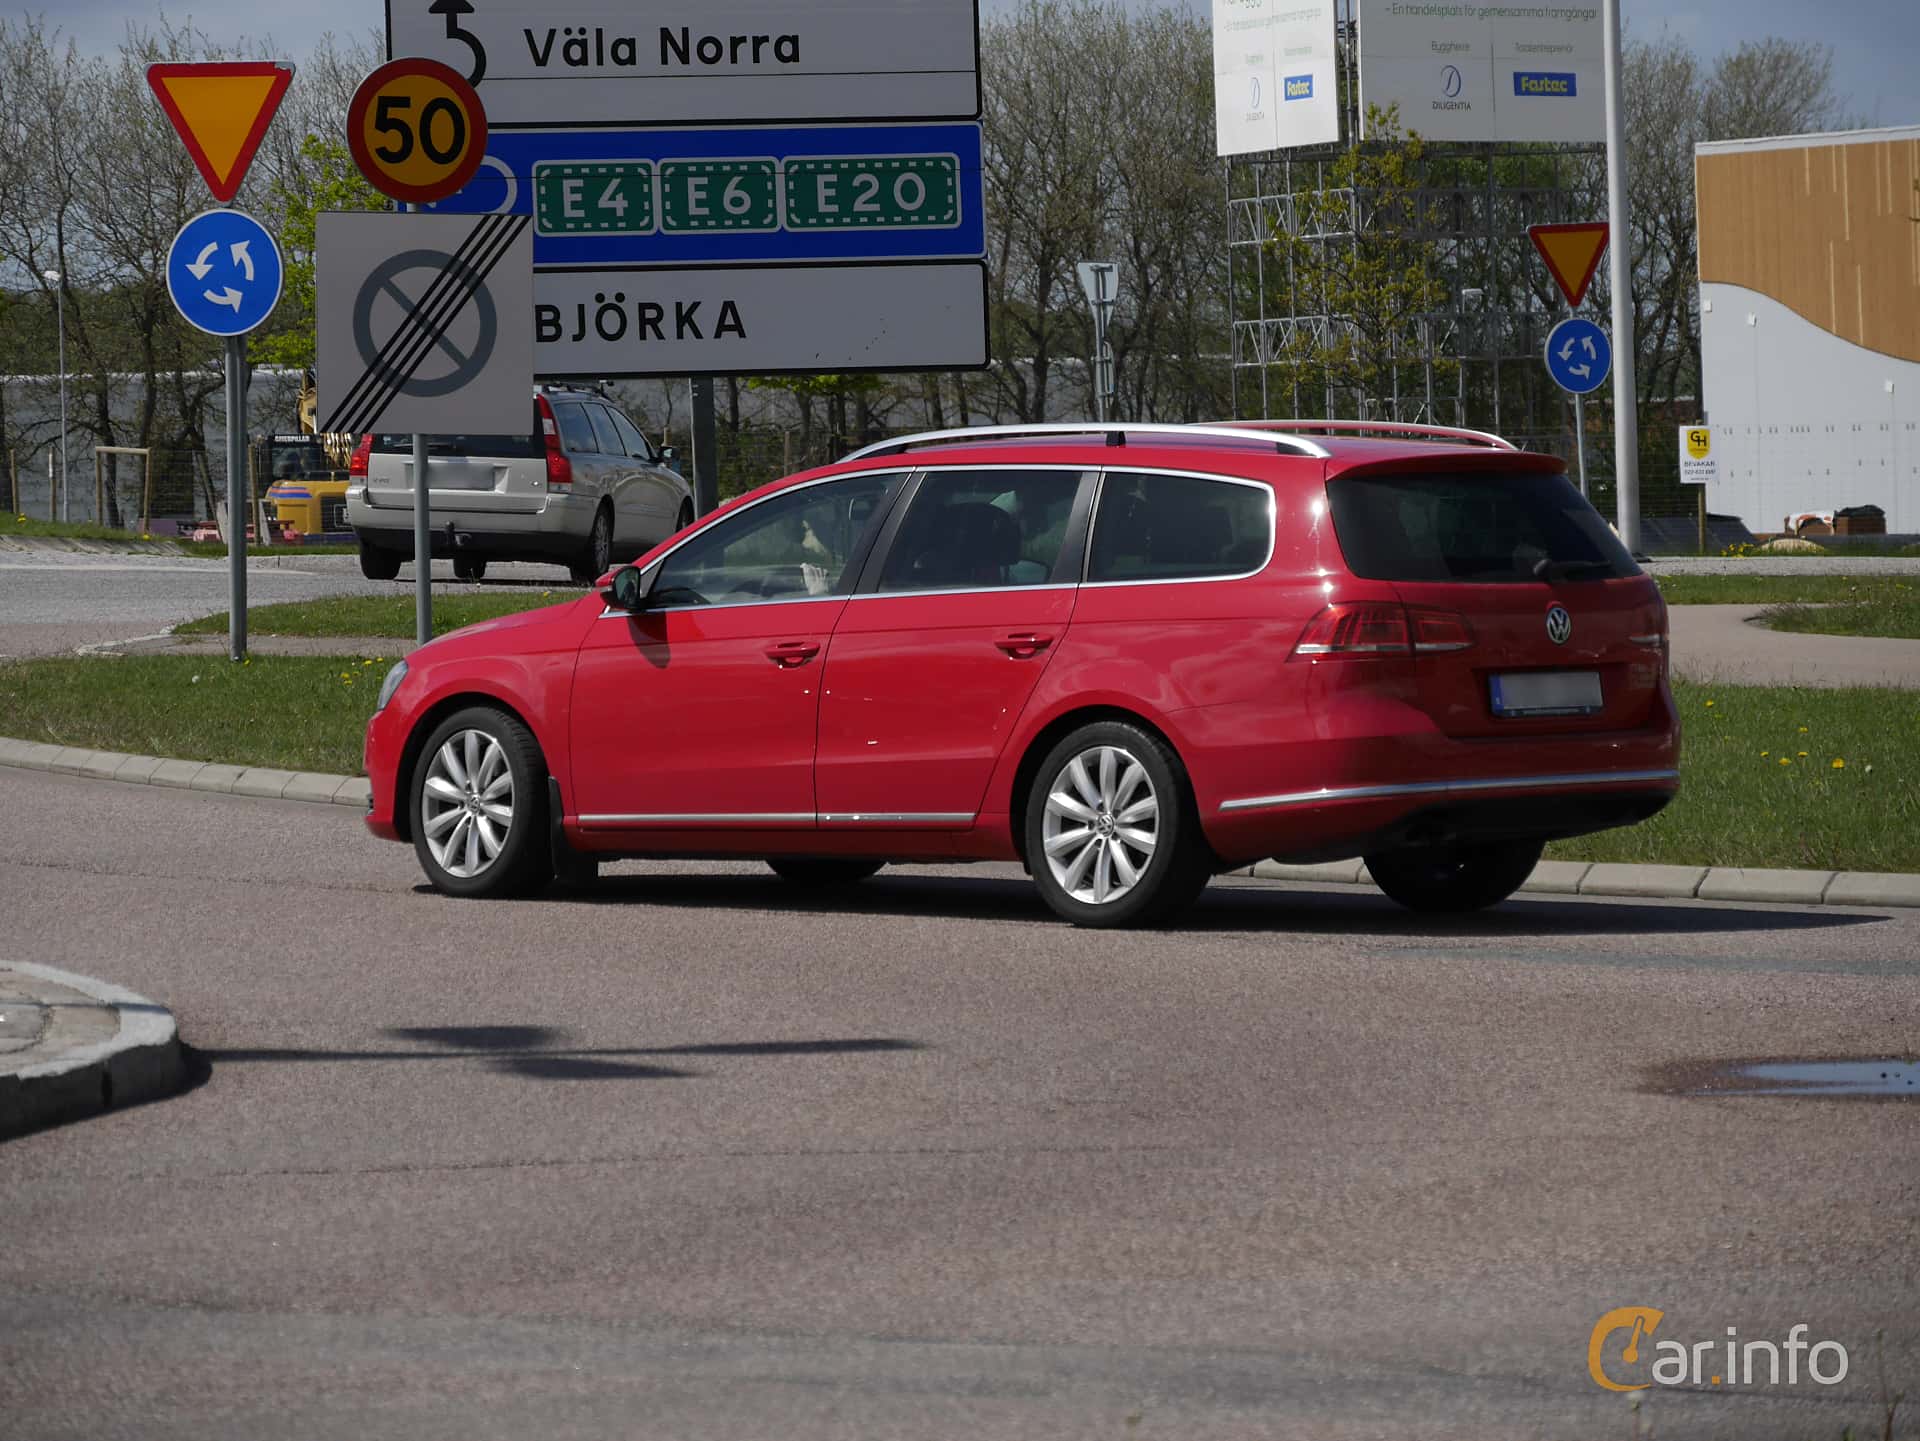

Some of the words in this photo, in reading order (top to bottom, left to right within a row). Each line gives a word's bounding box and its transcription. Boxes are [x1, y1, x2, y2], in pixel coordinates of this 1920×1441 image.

[1392, 2, 1404, 16] En
[1405, 3, 1463, 18] handelsplats
[1464, 4, 1475, 16] för
[1478, 6, 1543, 20] gemensamma
[524, 27, 636, 67] Väla
[660, 27, 800, 65] Norra
[1521, 76, 1568, 93] Fastec
[374, 96, 466, 165] 50
[563, 178, 629, 218] E4
[688, 176, 752, 215] E6
[816, 172, 926, 213] E20
[535, 291, 747, 343] BJÖRKA
